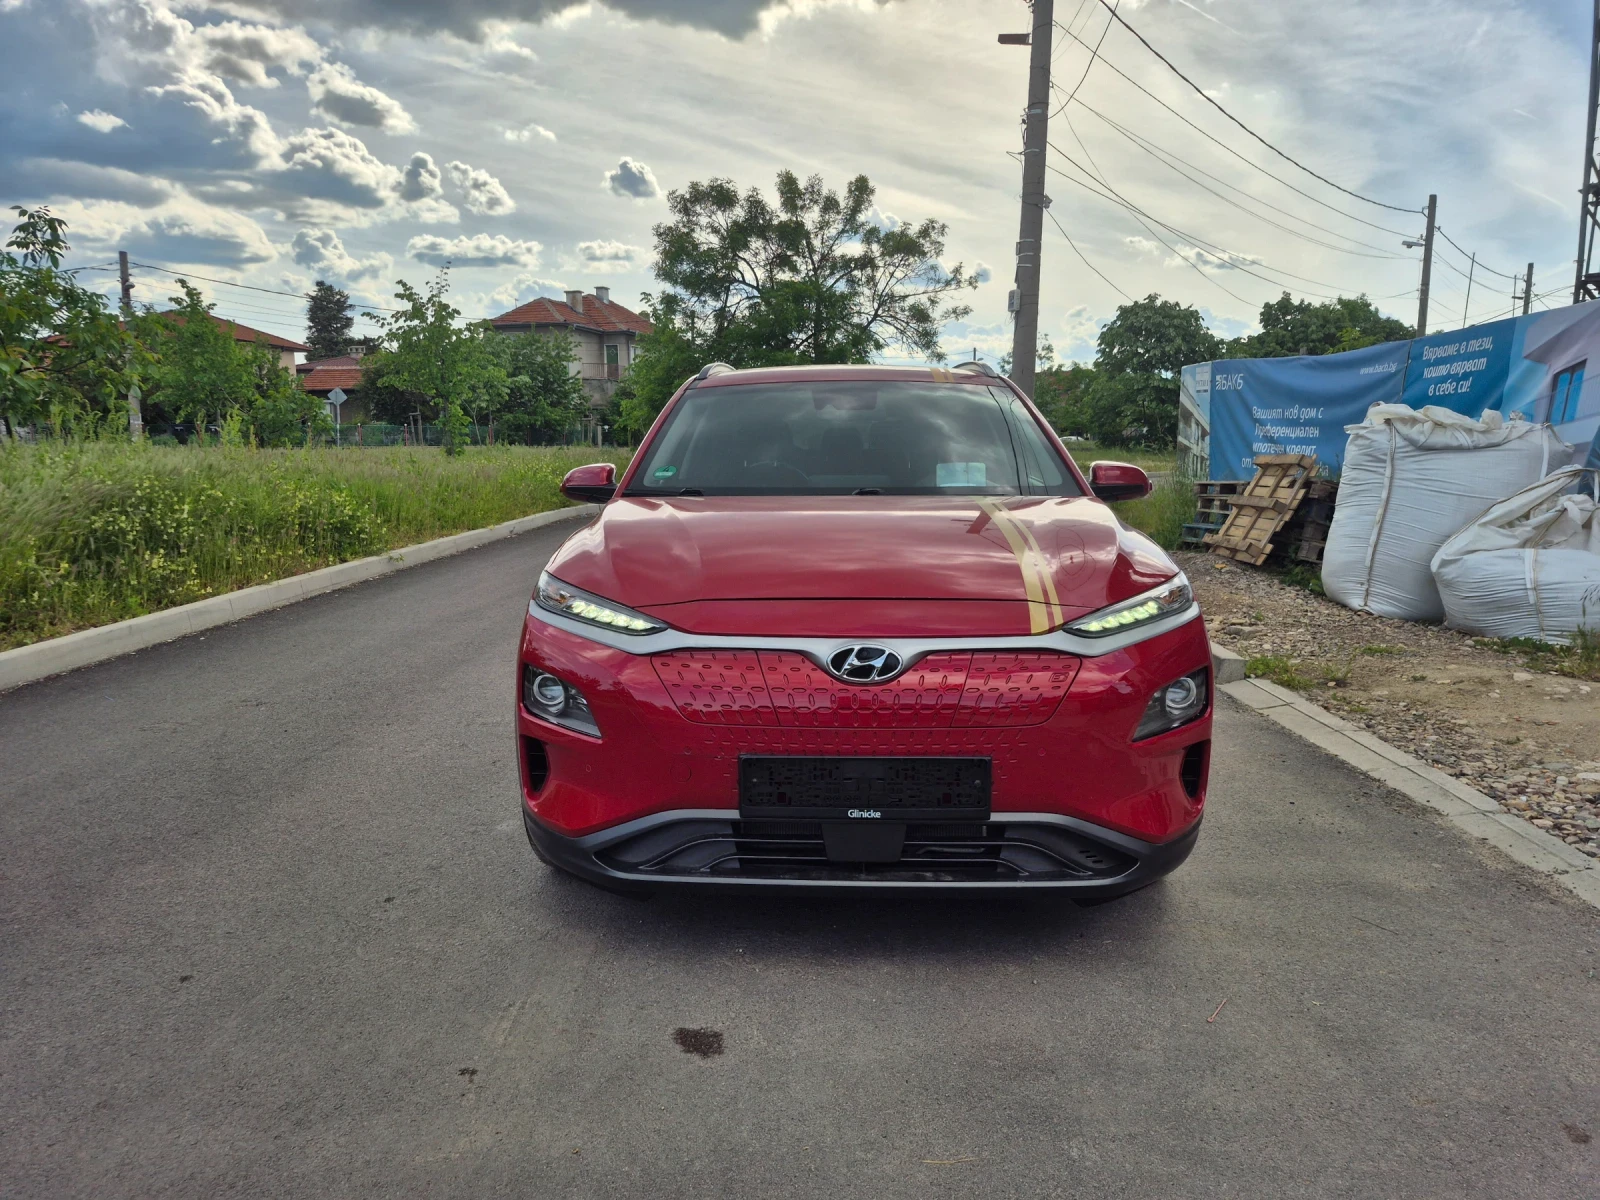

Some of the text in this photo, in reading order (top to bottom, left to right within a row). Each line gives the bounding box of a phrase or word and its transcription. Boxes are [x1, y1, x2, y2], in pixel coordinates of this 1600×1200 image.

[1423, 336, 1493, 362] Вярваме в тези,
[1423, 357, 1487, 379] които вярват
[1428, 376, 1473, 396] в себе си!
[1252, 406, 1283, 419] Вашият
[1284, 404, 1299, 419] нов
[1318, 407, 1324, 419] с
[847, 809, 881, 818] Glinicke
